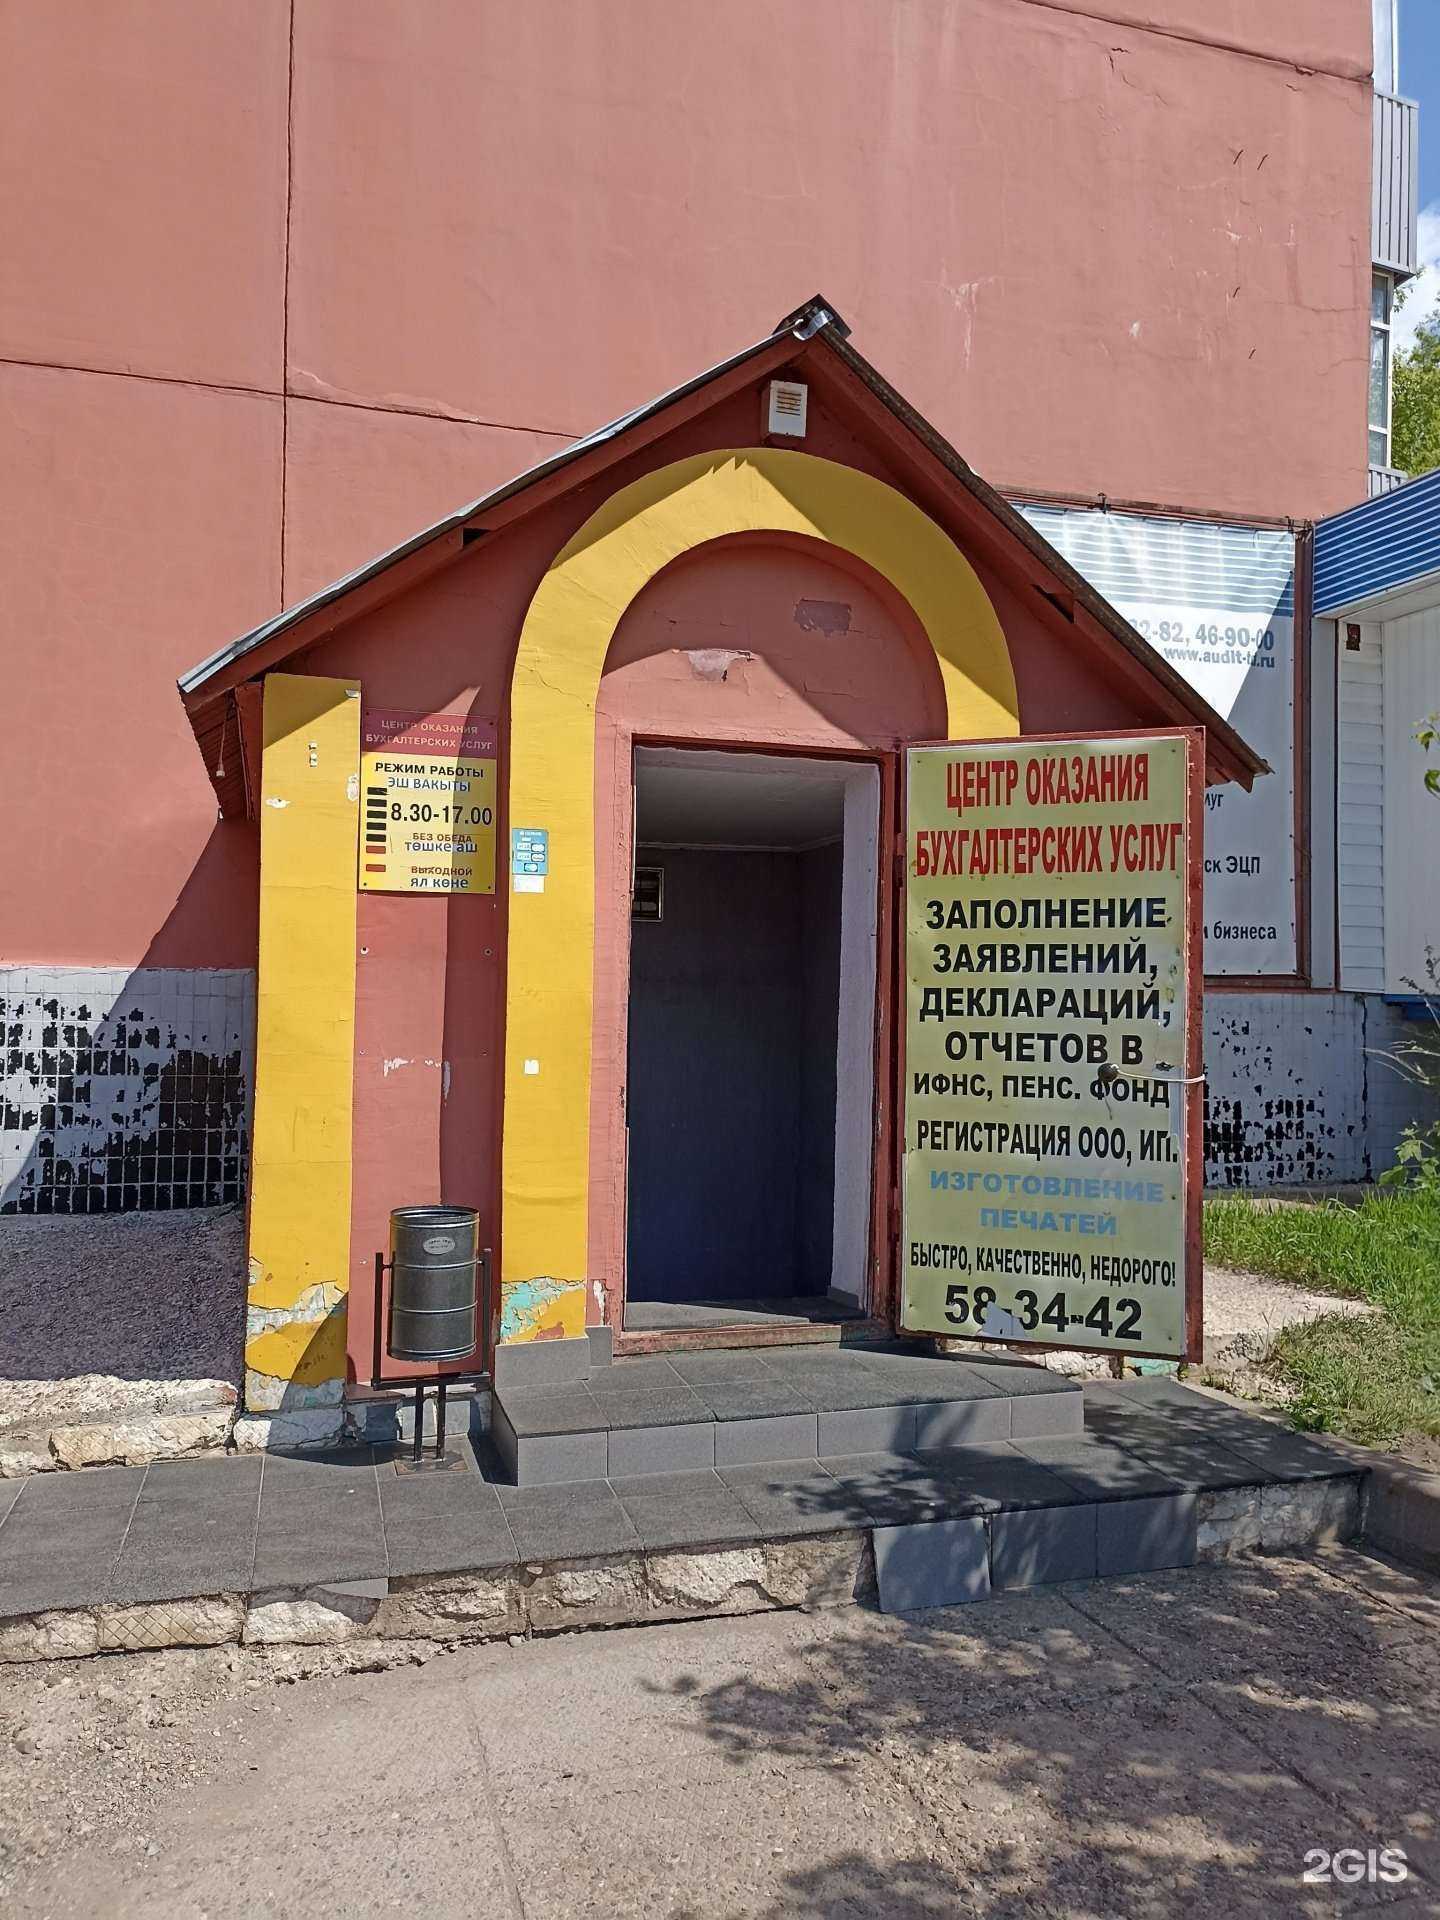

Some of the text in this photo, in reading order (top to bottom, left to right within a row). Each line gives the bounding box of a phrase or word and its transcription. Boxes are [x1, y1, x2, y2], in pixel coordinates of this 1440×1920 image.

[1195, 623, 1274, 651] 46-90-00
[365, 734, 456, 748] БУХГАЛТЕРСКИХ
[420, 722, 479, 734] ОКАЗАНИЯ
[375, 762, 484, 778] РЕЖИМ РАБОТЫ
[388, 777, 471, 792] ЭШ ВАКЫТЫ
[946, 753, 1149, 818] ЦЕНТР ОКАЗАНИЯ
[391, 802, 493, 826] 8.30-17.00
[412, 832, 473, 843] БЕЗ ОБЕДА
[916, 823, 1183, 877] БУХГАЛТЕРСКИХ УСЛУГ
[1226, 856, 1260, 876] ЭЦП
[926, 897, 1167, 930] ЗАПОЛНЕНИЕ
[1213, 921, 1277, 940] бизнеса
[933, 936, 1158, 980] ЗАЯВЛЕНИЙ,
[919, 982, 1171, 1028] ДЕКЛАРАЦИЙ,
[945, 1031, 1144, 1065] ОТЧЕТОВ В
[913, 1073, 1170, 1108] ИФНС, ПЕНС. ФОНД
[917, 1119, 1178, 1167] РЕГИСТРАЦИЯ ООО, ИП.
[930, 1170, 1164, 1203] ИЗГОТОВЛЕНИЕ
[979, 1208, 1118, 1236] ПЕЧАТЕЙ
[910, 1242, 1176, 1287] БЫСТРО, КАЧЕСТВЕННО, НЕДОРОГО!
[944, 1284, 1142, 1340] 58-34-42
